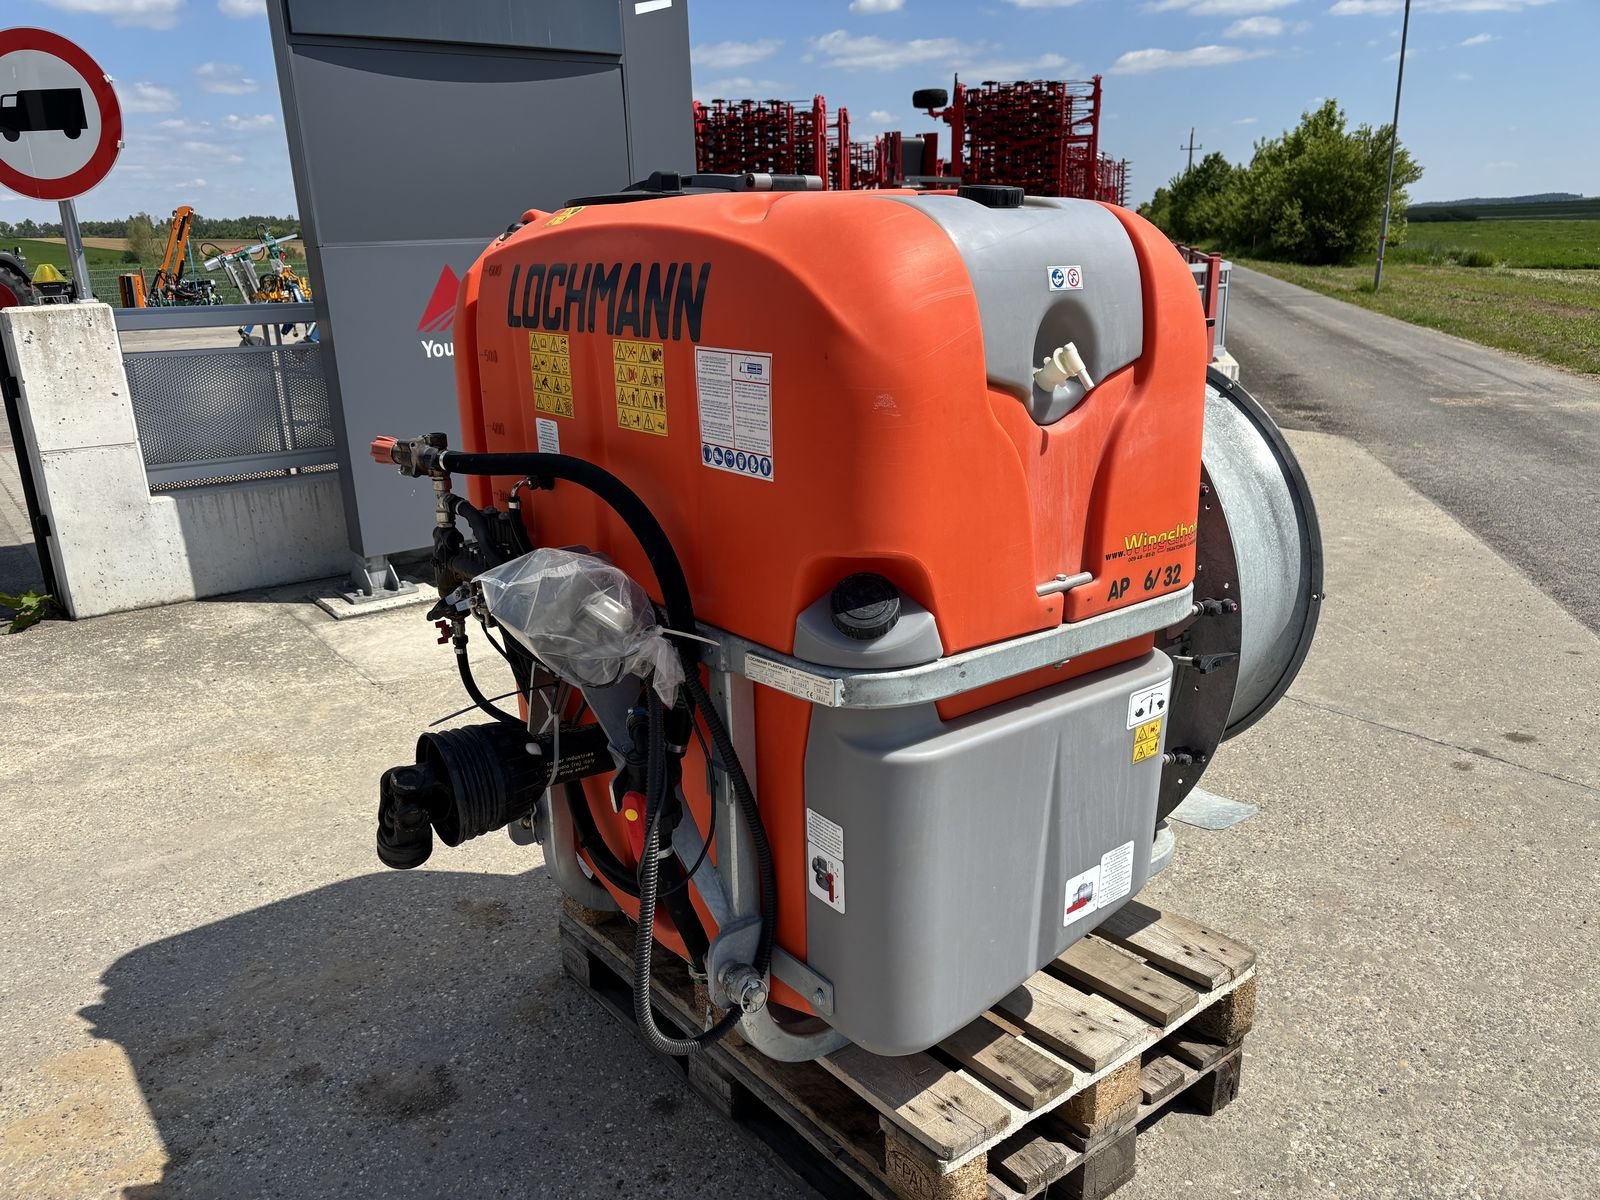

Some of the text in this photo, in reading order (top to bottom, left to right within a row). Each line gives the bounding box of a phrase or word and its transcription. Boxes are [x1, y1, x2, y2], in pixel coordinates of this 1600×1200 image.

[508, 263, 711, 343] LOCHMANN
[421, 340, 454, 359] You
[1107, 577, 1131, 602] AP
[566, 752, 594, 761] industries
